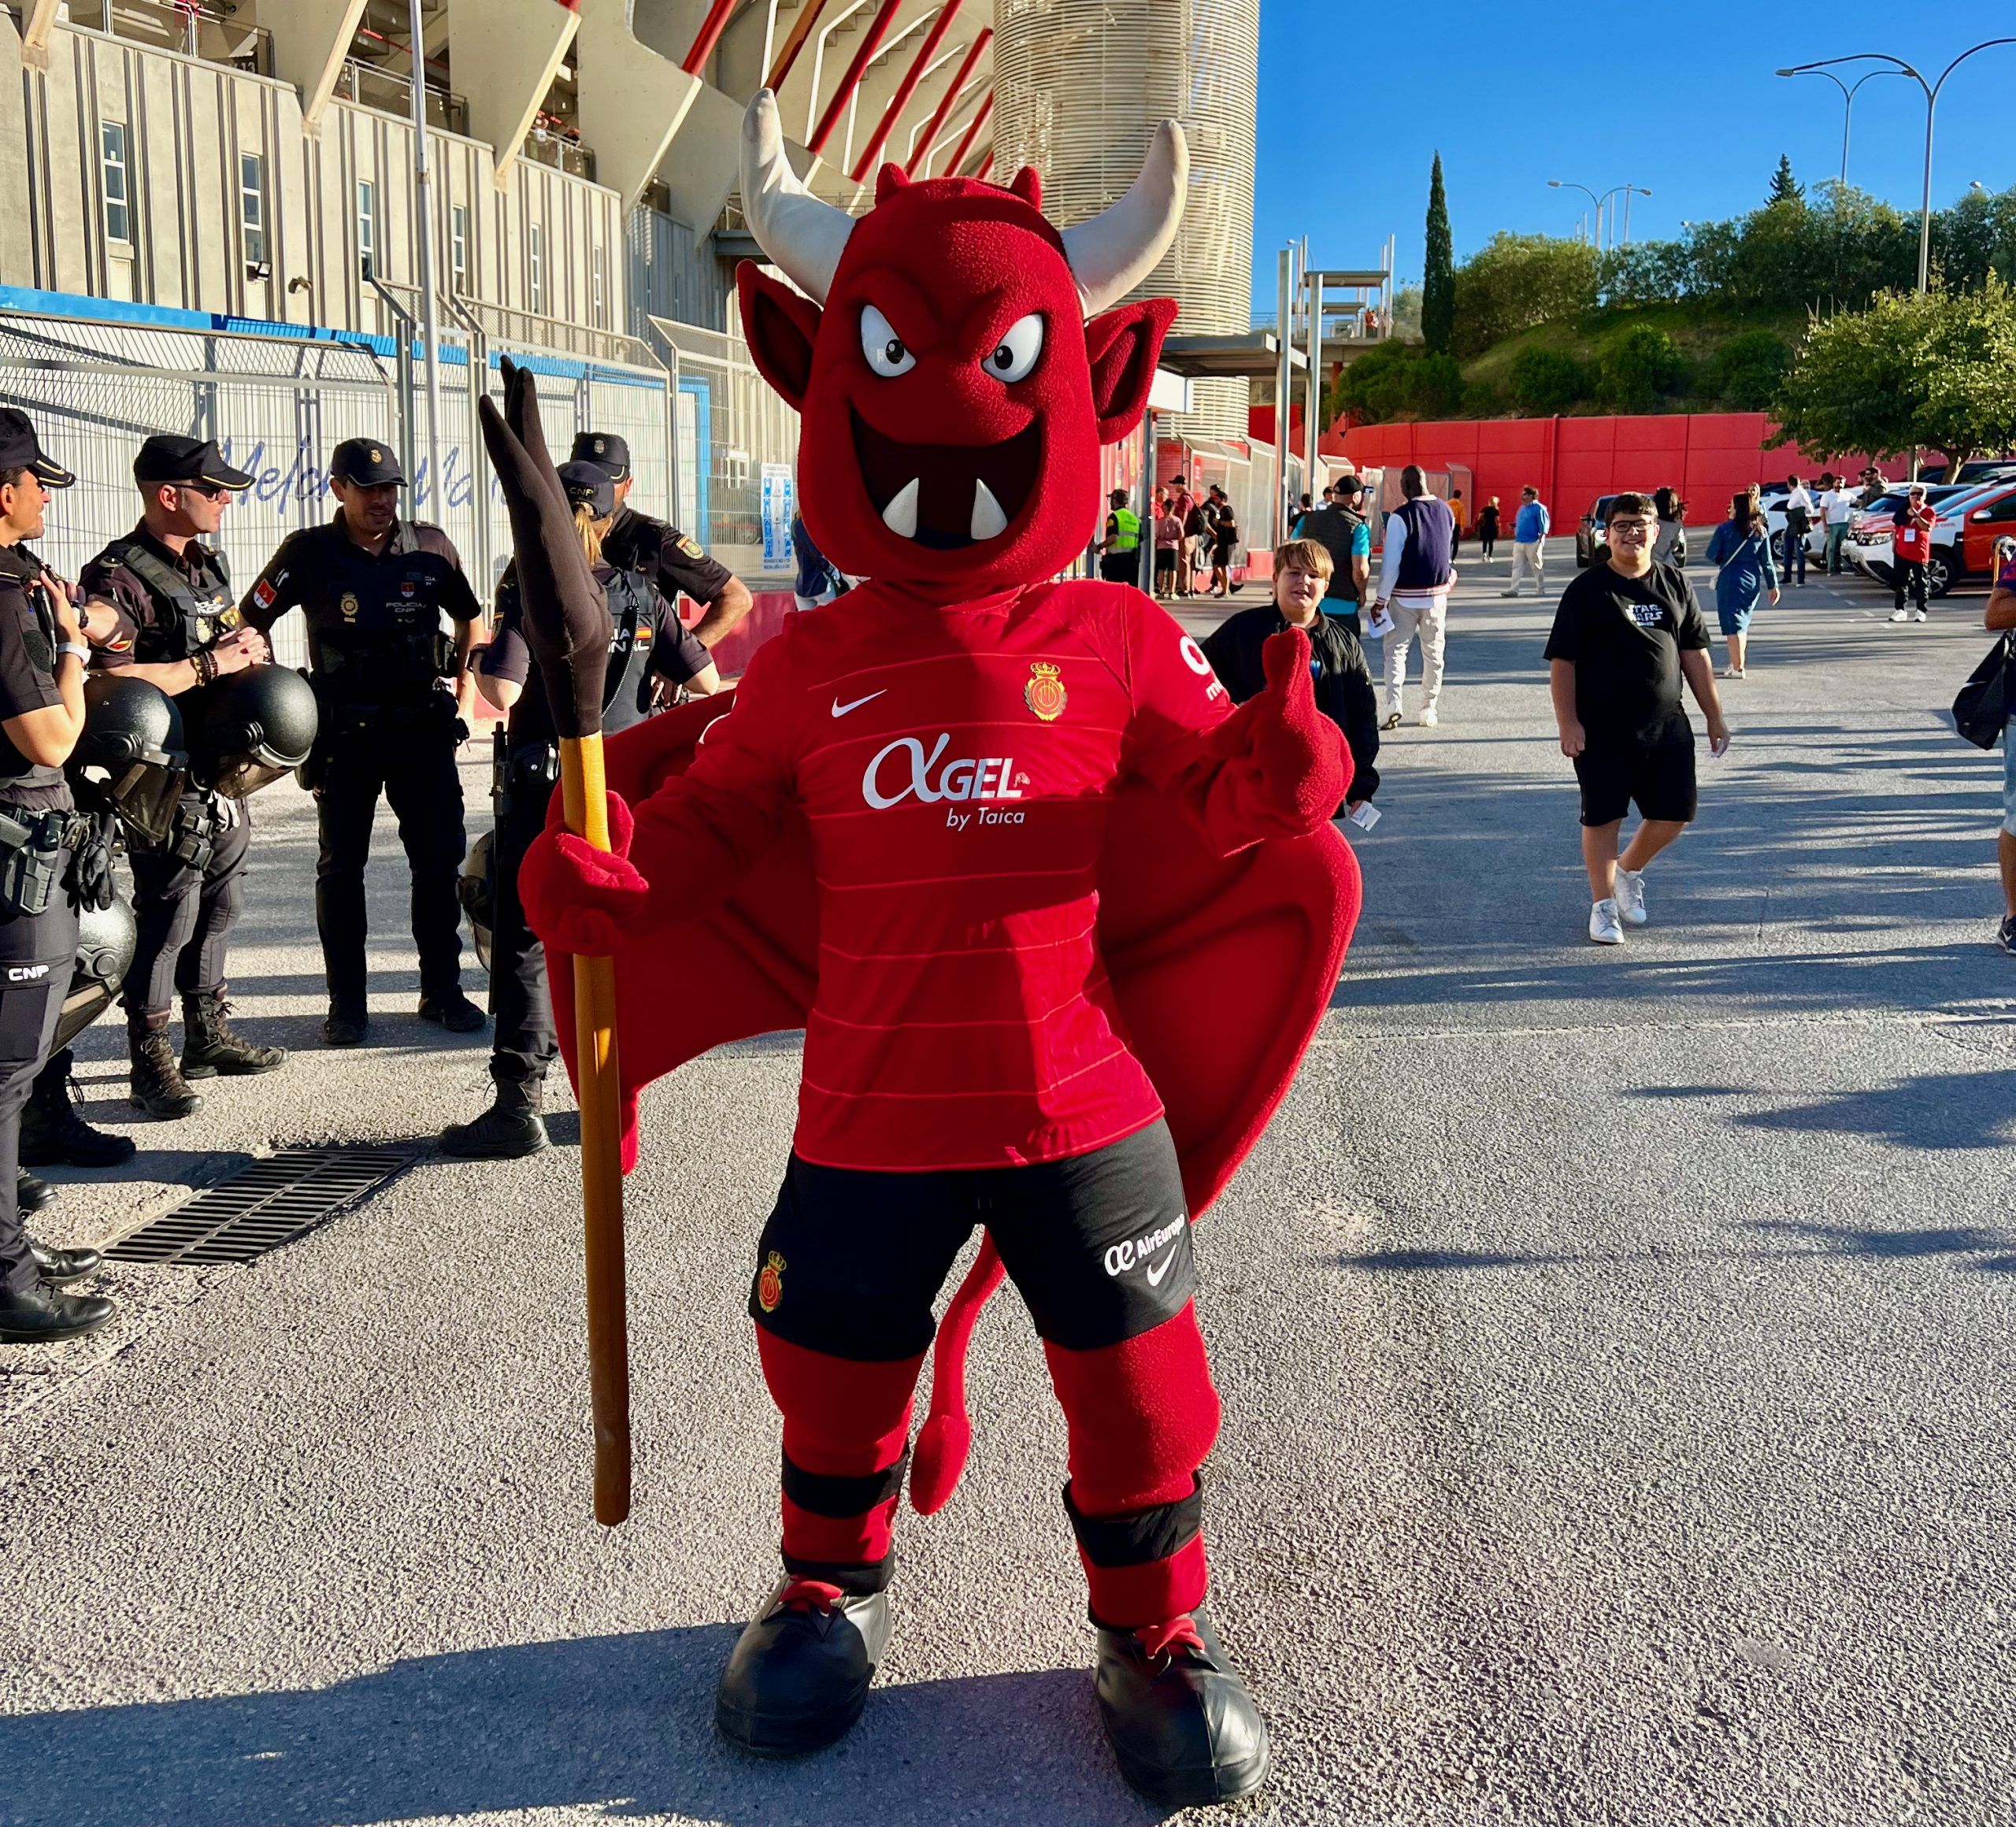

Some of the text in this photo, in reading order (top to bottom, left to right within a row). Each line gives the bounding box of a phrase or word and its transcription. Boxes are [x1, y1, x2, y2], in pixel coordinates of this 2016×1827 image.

[569, 487, 594, 497] CNP
[946, 806, 1025, 832] by Taica
[8, 964, 50, 981] CNP
